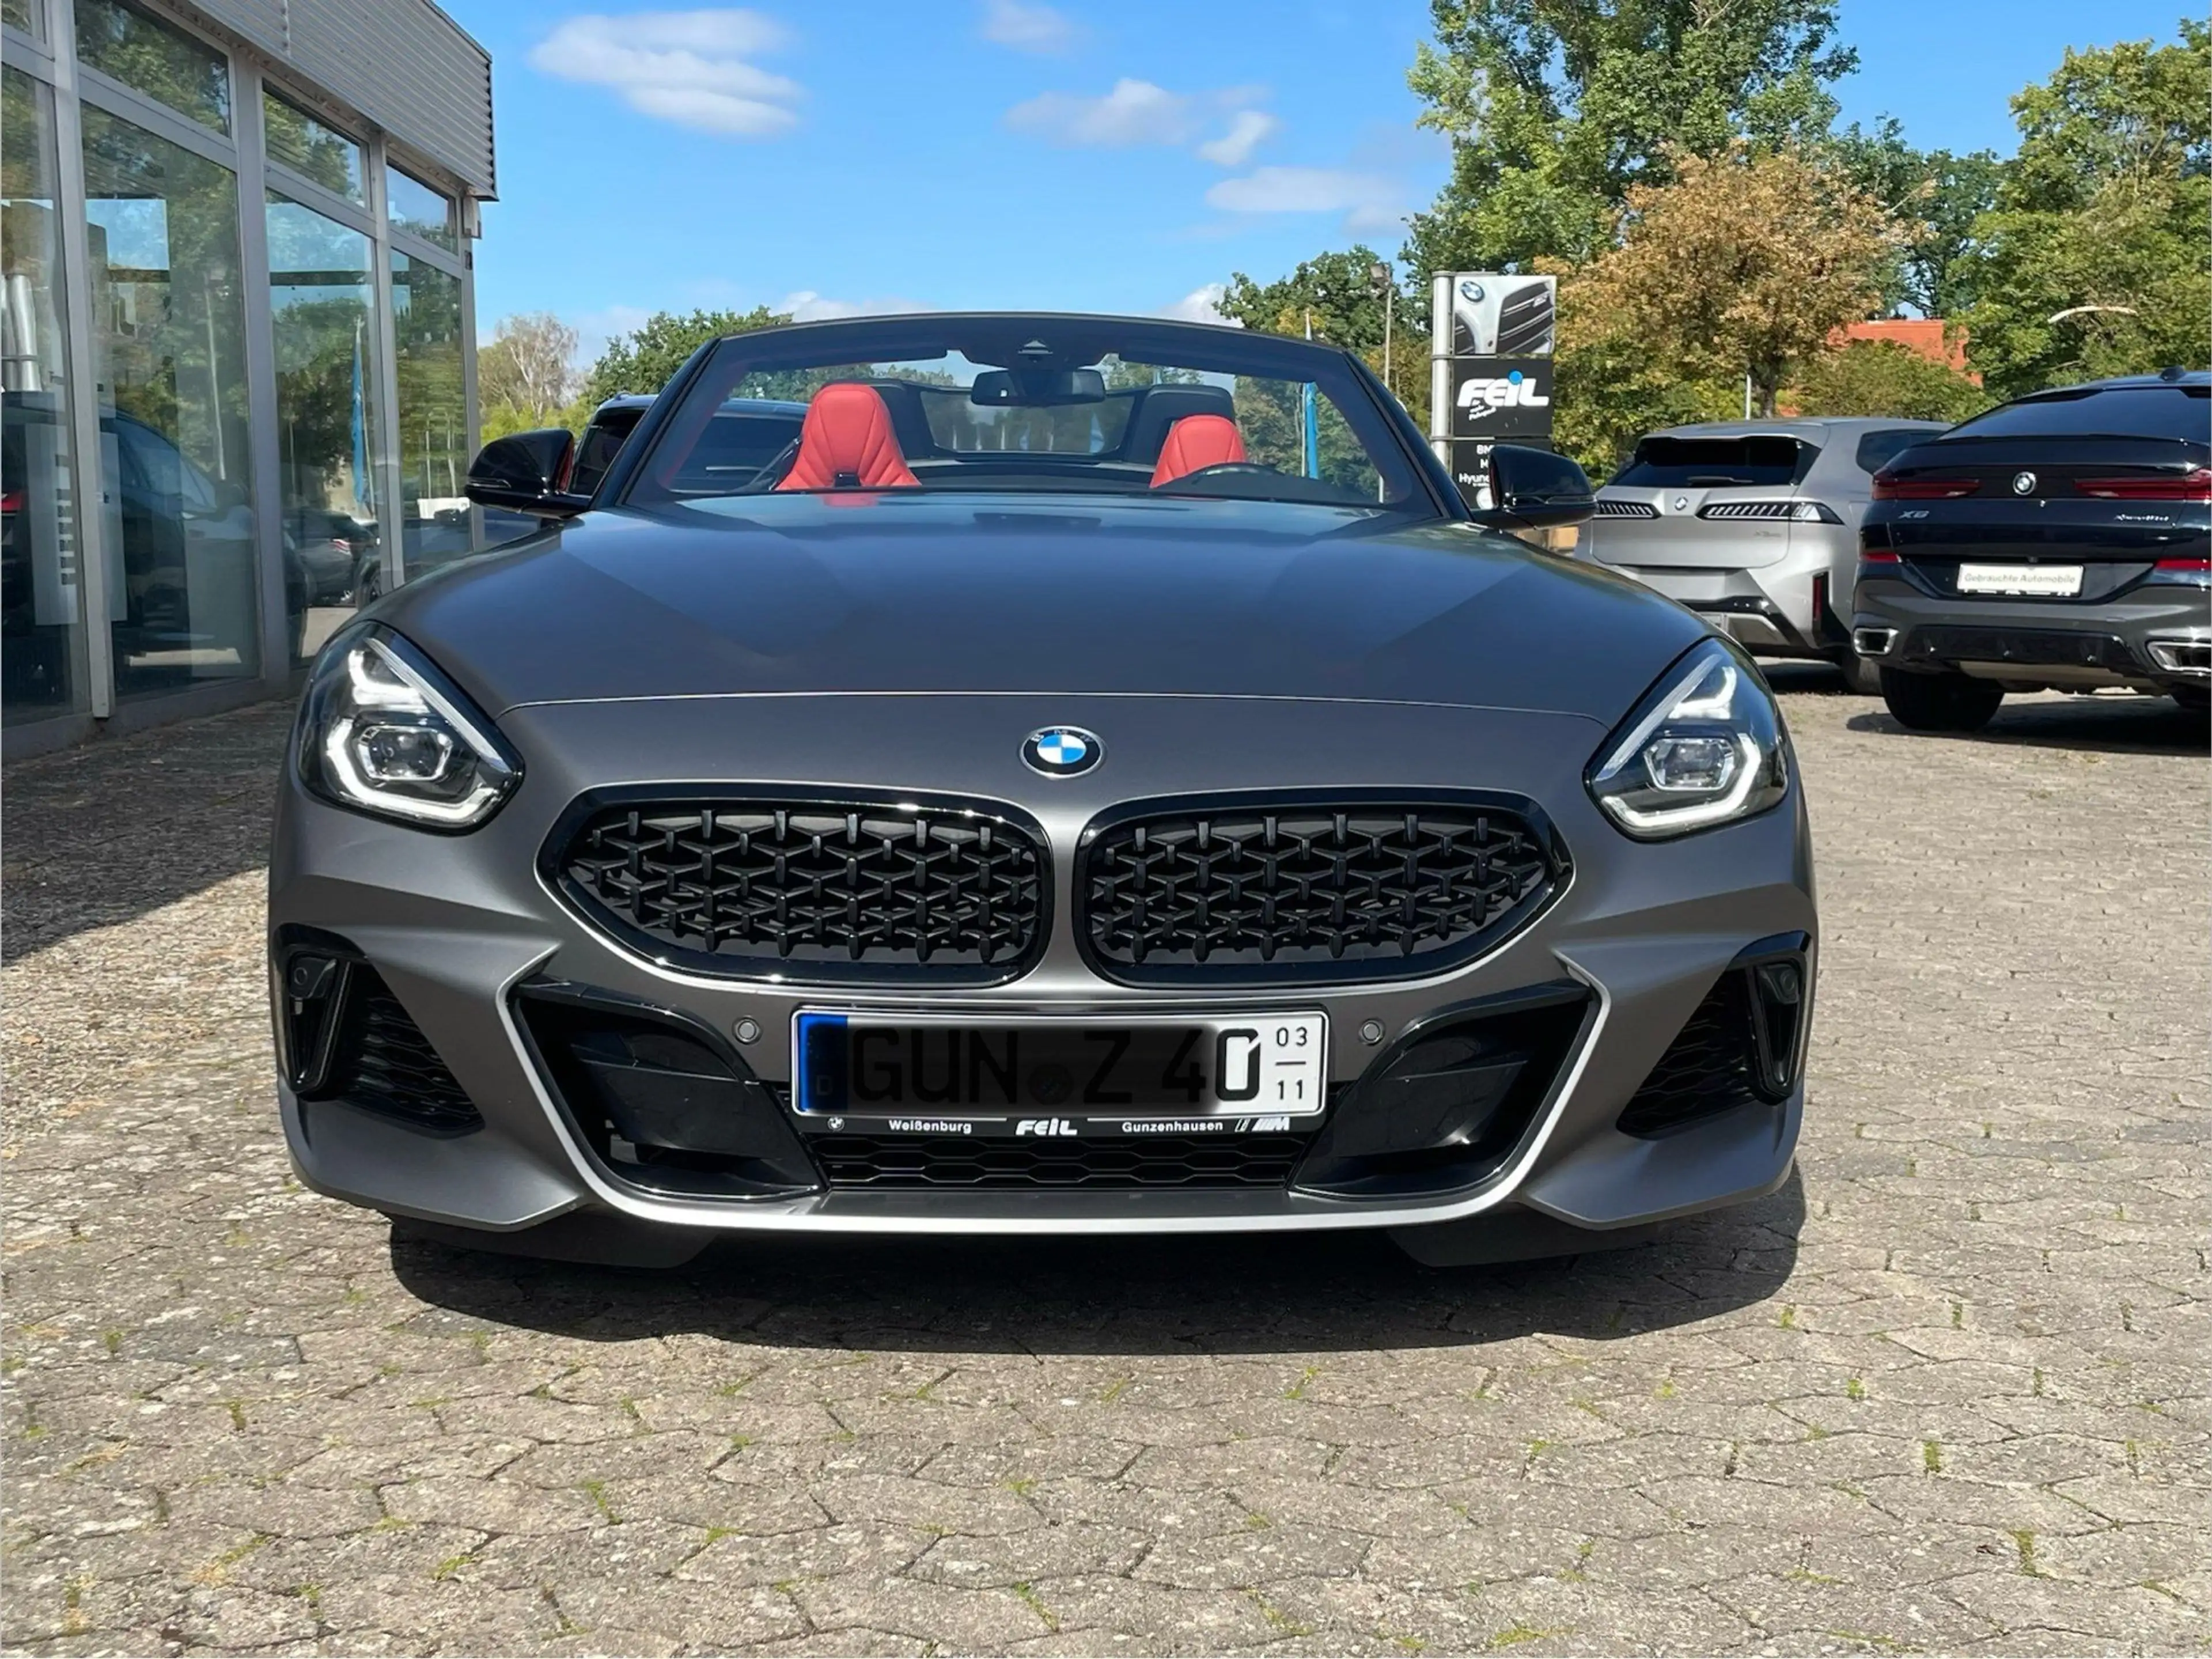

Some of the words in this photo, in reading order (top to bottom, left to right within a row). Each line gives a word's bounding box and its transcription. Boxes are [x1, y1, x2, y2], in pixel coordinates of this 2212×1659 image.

[1964, 573, 2018, 582] Gebrauchte
[2020, 574, 2076, 584] Automobile
[1276, 1027, 1308, 1047] 03
[853, 1028, 1018, 1104] GUN
[1083, 1029, 1132, 1104] Z
[1161, 1028, 1261, 1103] 40
[1277, 1079, 1303, 1100] 11
[888, 1119, 972, 1134] Weißenburg
[1122, 1121, 1224, 1133] Gunzenhausen
